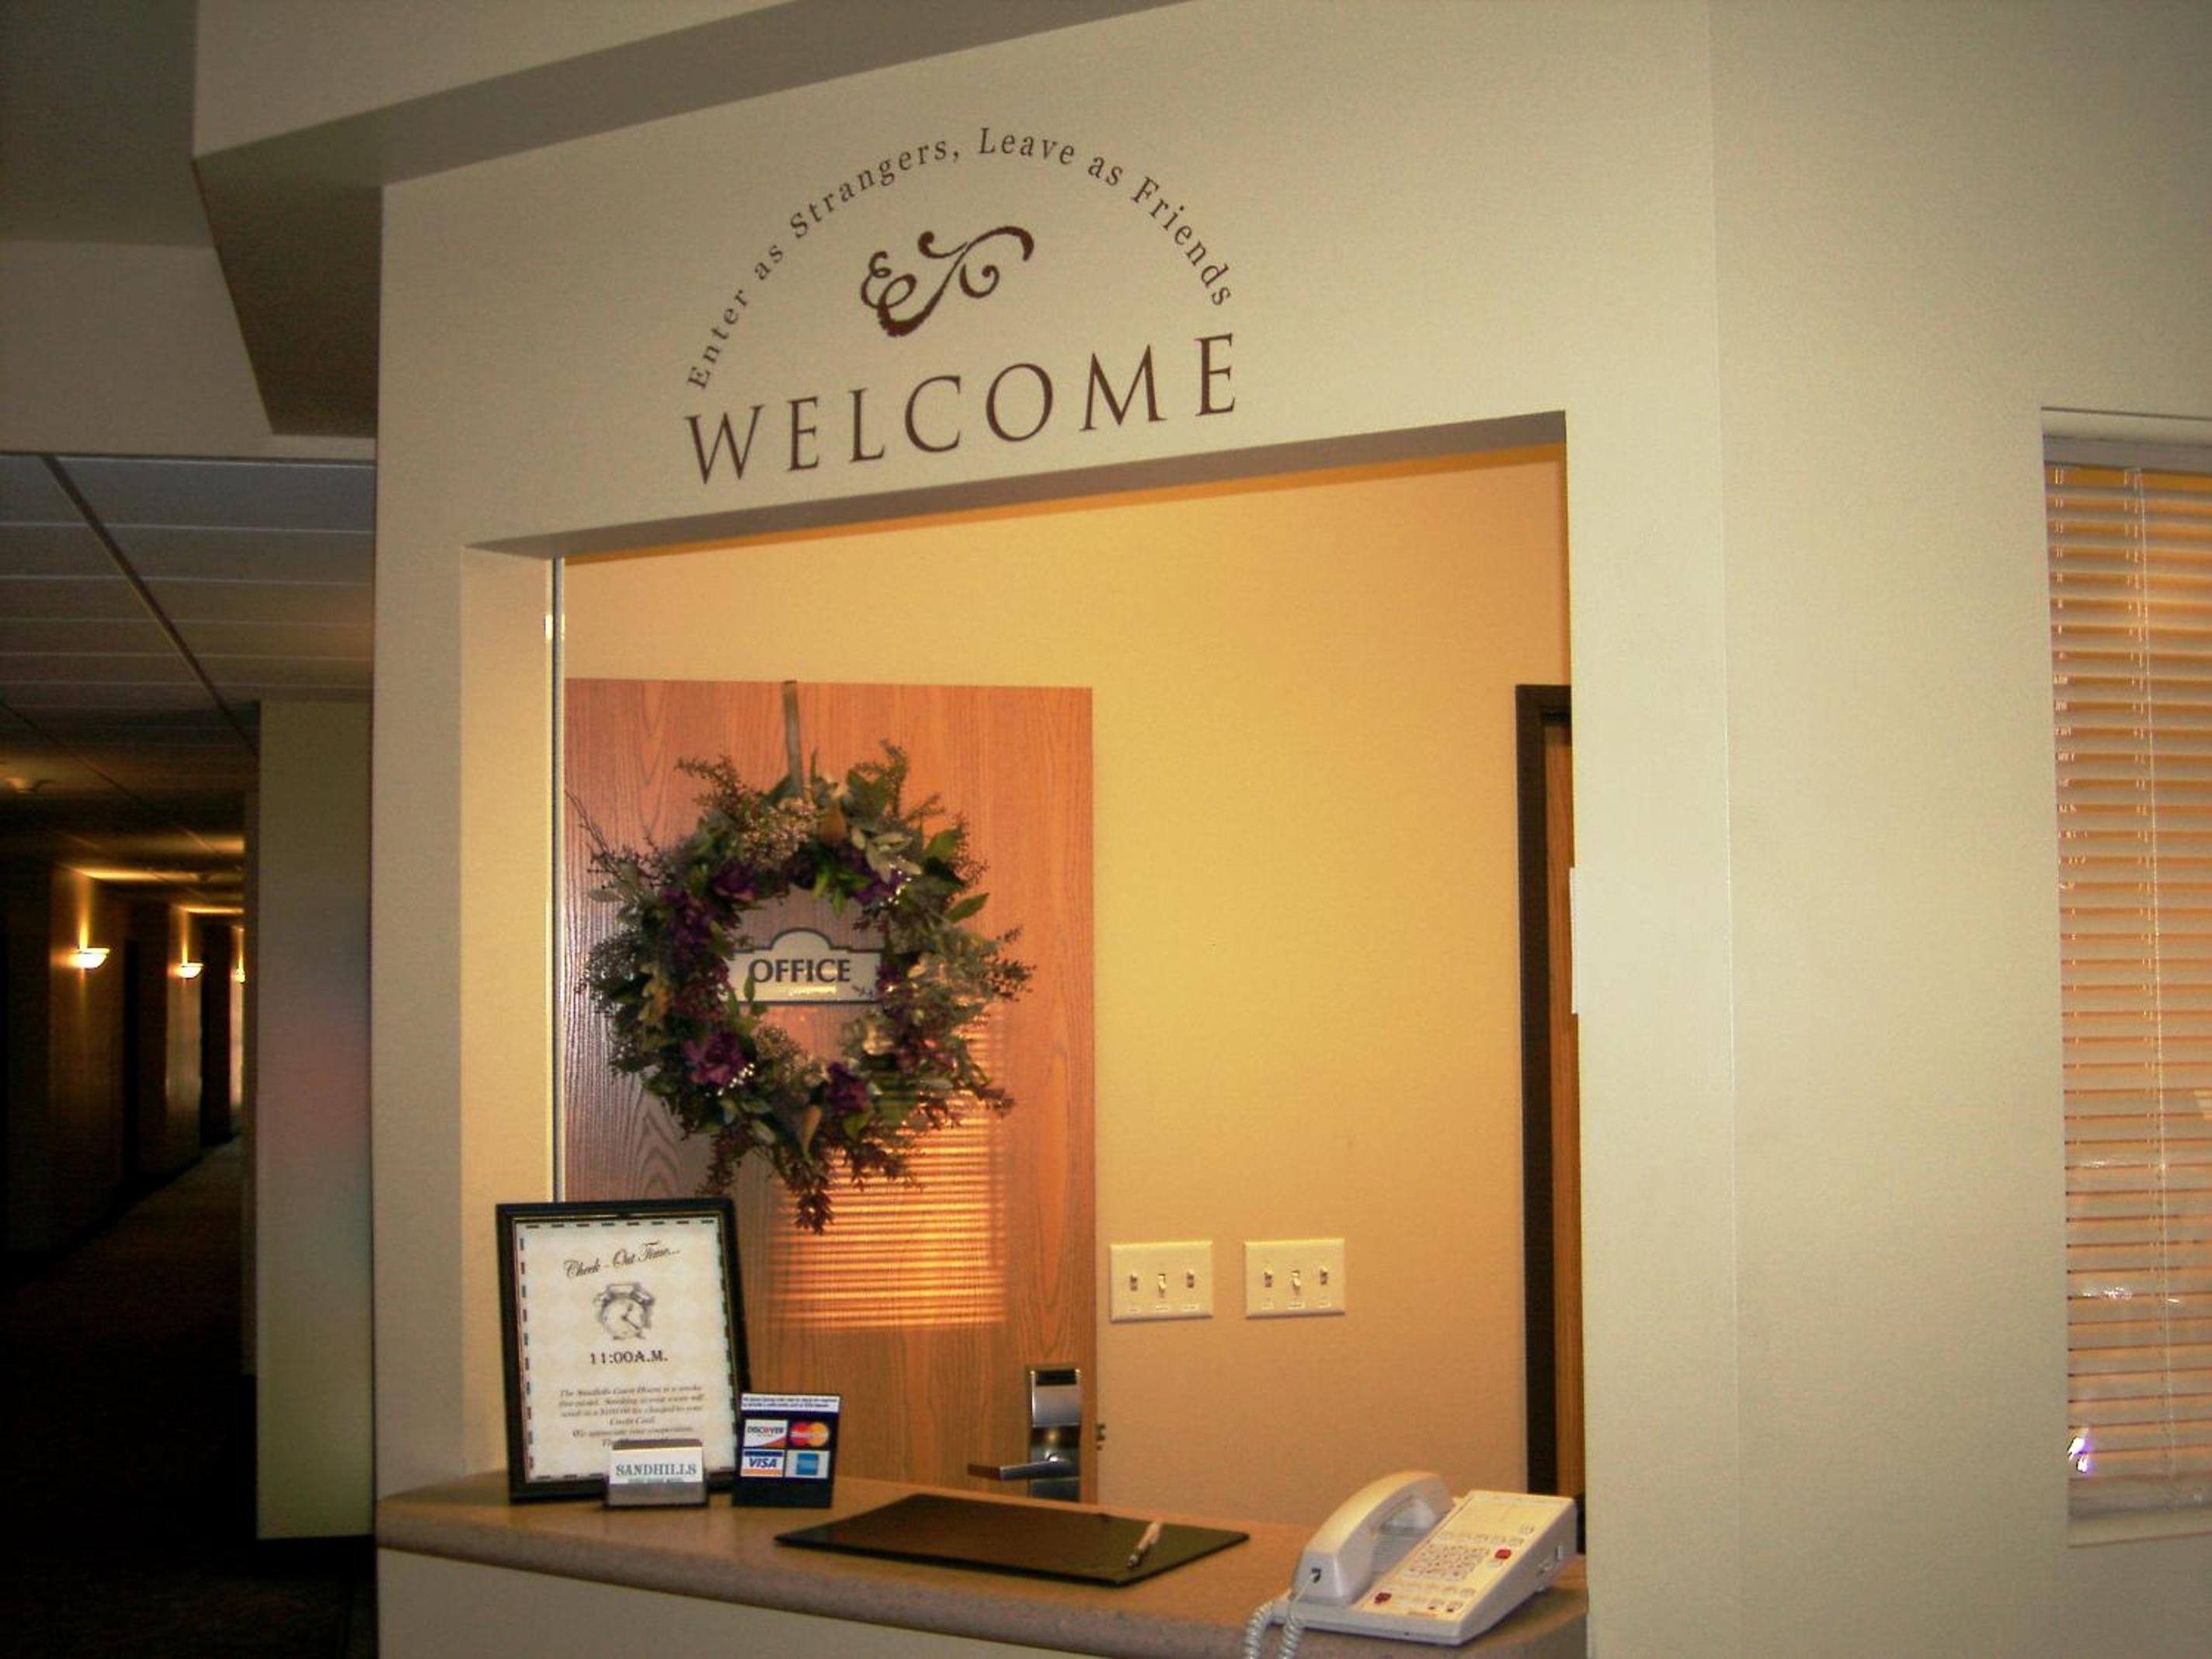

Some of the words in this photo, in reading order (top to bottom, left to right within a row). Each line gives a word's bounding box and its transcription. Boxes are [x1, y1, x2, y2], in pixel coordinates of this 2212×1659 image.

[687, 287, 750, 390] Enter
[753, 242, 784, 281] as
[788, 138, 962, 238] Strangers,
[978, 126, 1076, 167] Leave
[1087, 155, 1123, 186] as
[1130, 176, 1232, 308] Friends
[683, 332, 1237, 485] WELCOME
[749, 957, 851, 983] OFFICE
[616, 1463, 697, 1476] SANDHILLS
[749, 1458, 777, 1469] VISA
